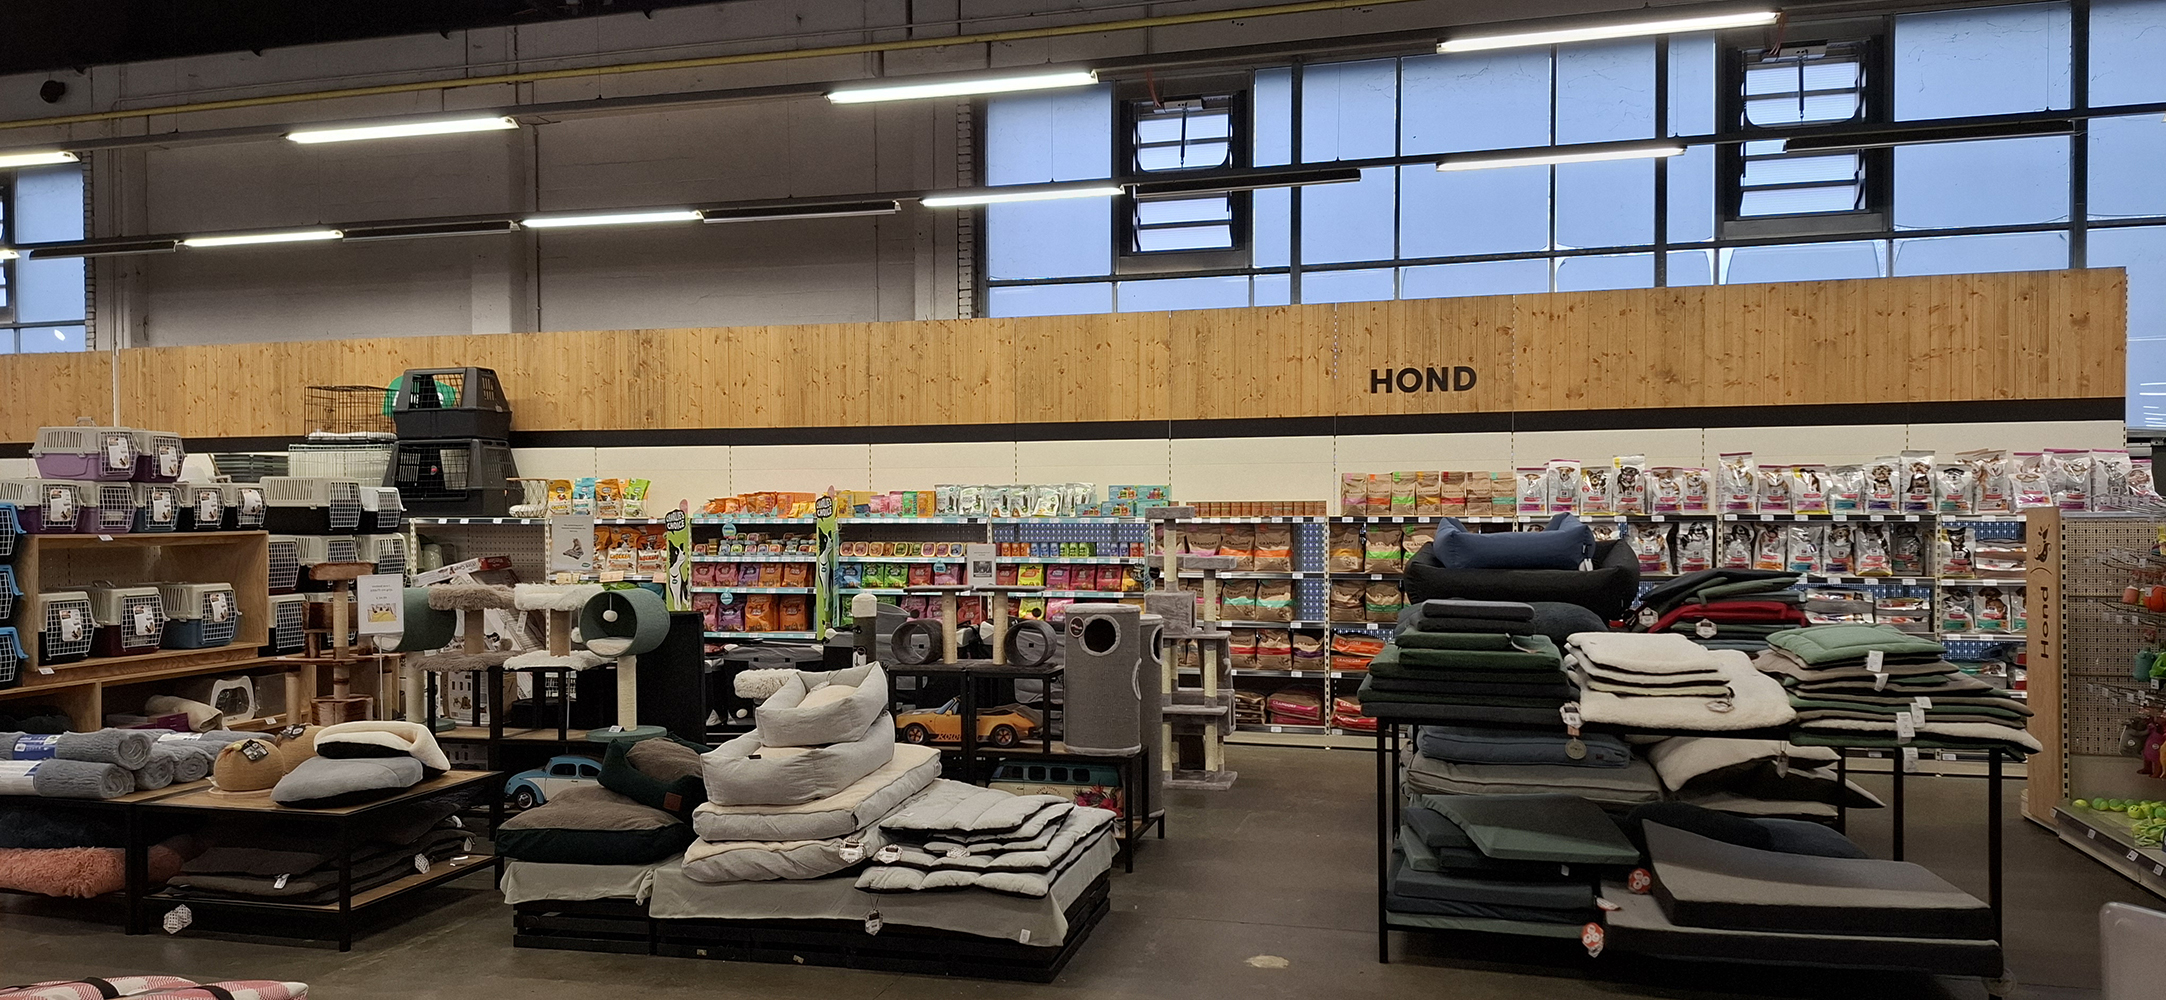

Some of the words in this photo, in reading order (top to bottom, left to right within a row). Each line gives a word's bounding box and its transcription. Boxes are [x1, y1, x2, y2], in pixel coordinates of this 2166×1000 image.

[1371, 366, 1477, 394] HOND
[667, 520, 685, 530] CHOICE
[2040, 586, 2049, 659] Hond
